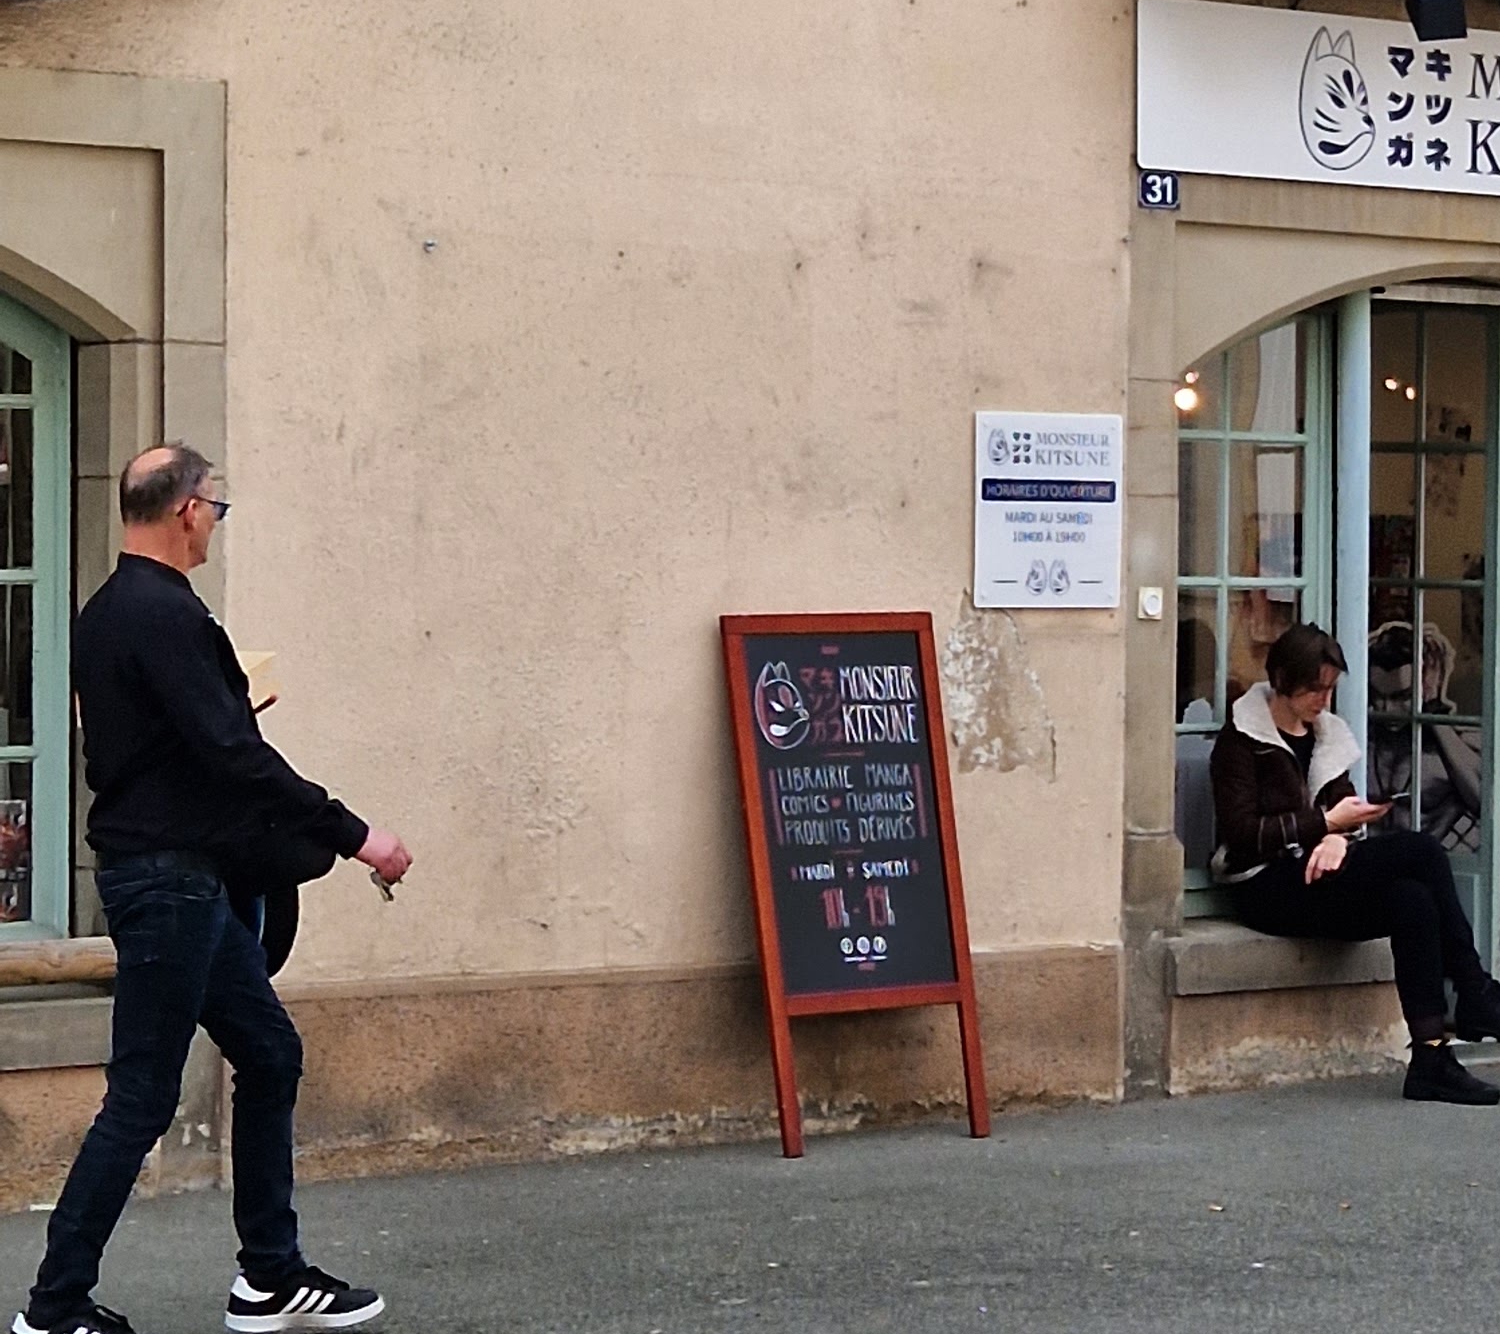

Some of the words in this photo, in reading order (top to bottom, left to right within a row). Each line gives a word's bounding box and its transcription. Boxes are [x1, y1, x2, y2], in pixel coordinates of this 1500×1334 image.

[1387, 46, 1414, 167] マンガ
[1424, 49, 1452, 171] キツネ
[1146, 175, 1173, 204] 31
[1036, 432, 1109, 447] MONSIEUR
[1035, 449, 1110, 466] KITSUNE
[986, 483, 1038, 497] HORAIRES
[1005, 511, 1037, 523] MARDI
[1040, 512, 1053, 523] AU
[1056, 512, 1093, 524] SAMEDI
[838, 665, 918, 701] MONSIEUR
[842, 703, 919, 744] KITSUNE
[777, 765, 854, 792] LIBRAIRIE
[864, 762, 913, 787] MANGA
[781, 794, 830, 816] COMICS
[846, 790, 916, 813] FIGURINES
[784, 818, 851, 846] PRODUITS
[861, 858, 909, 880] SAMEDI
